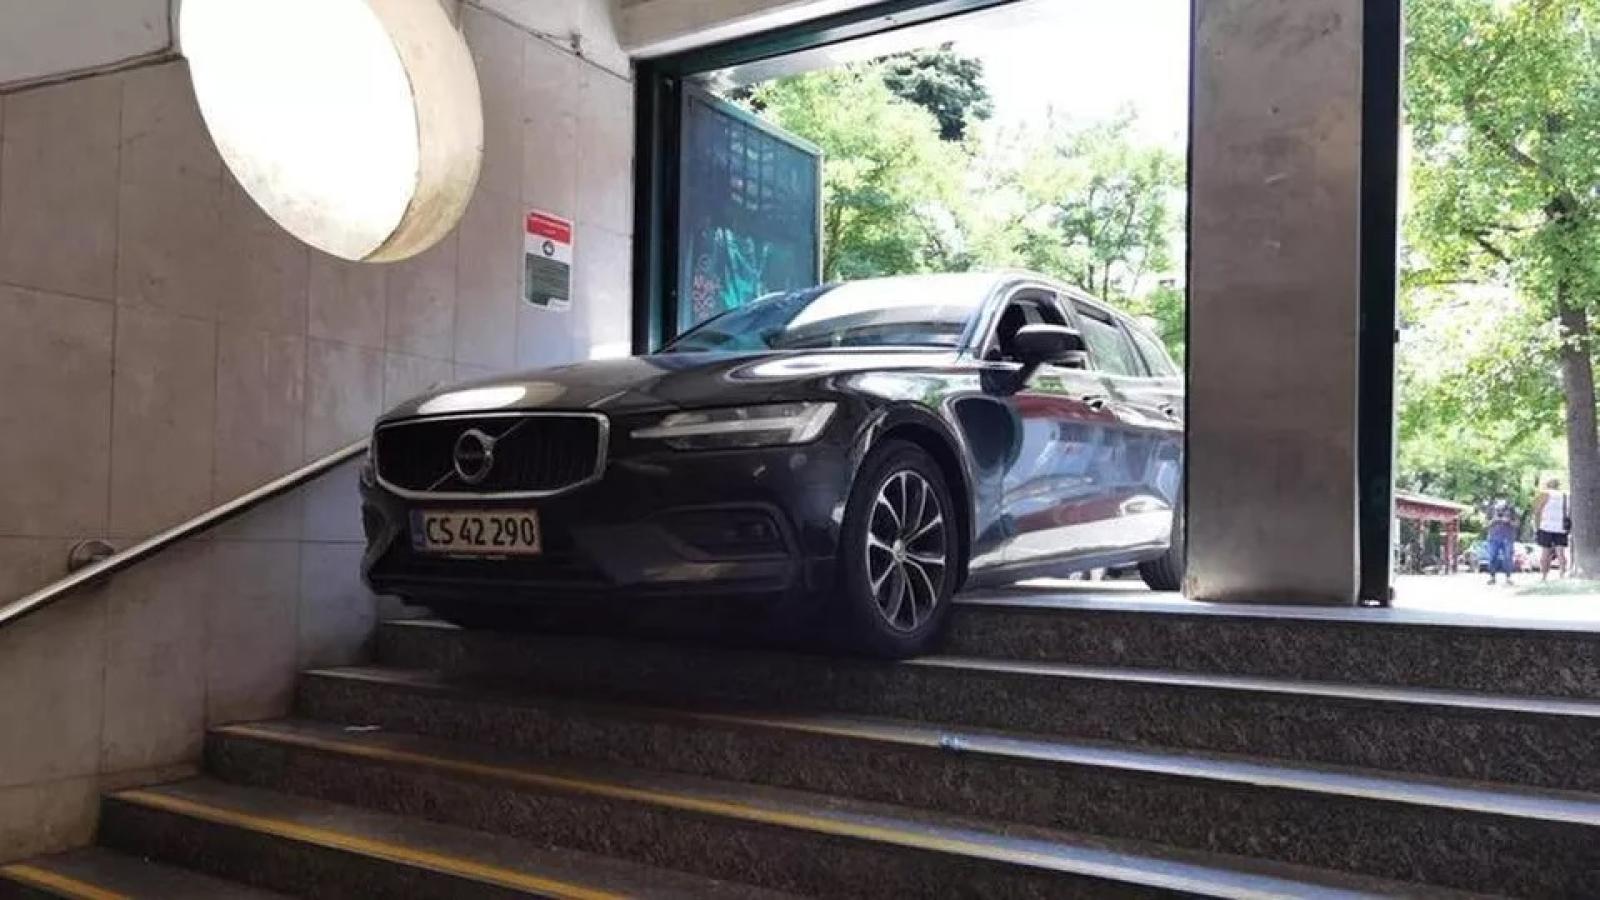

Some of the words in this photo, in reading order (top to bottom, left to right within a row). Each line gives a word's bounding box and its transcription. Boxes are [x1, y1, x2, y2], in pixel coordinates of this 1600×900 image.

[426, 517, 454, 545] CS
[459, 517, 487, 546] 42
[490, 517, 535, 546] 290
